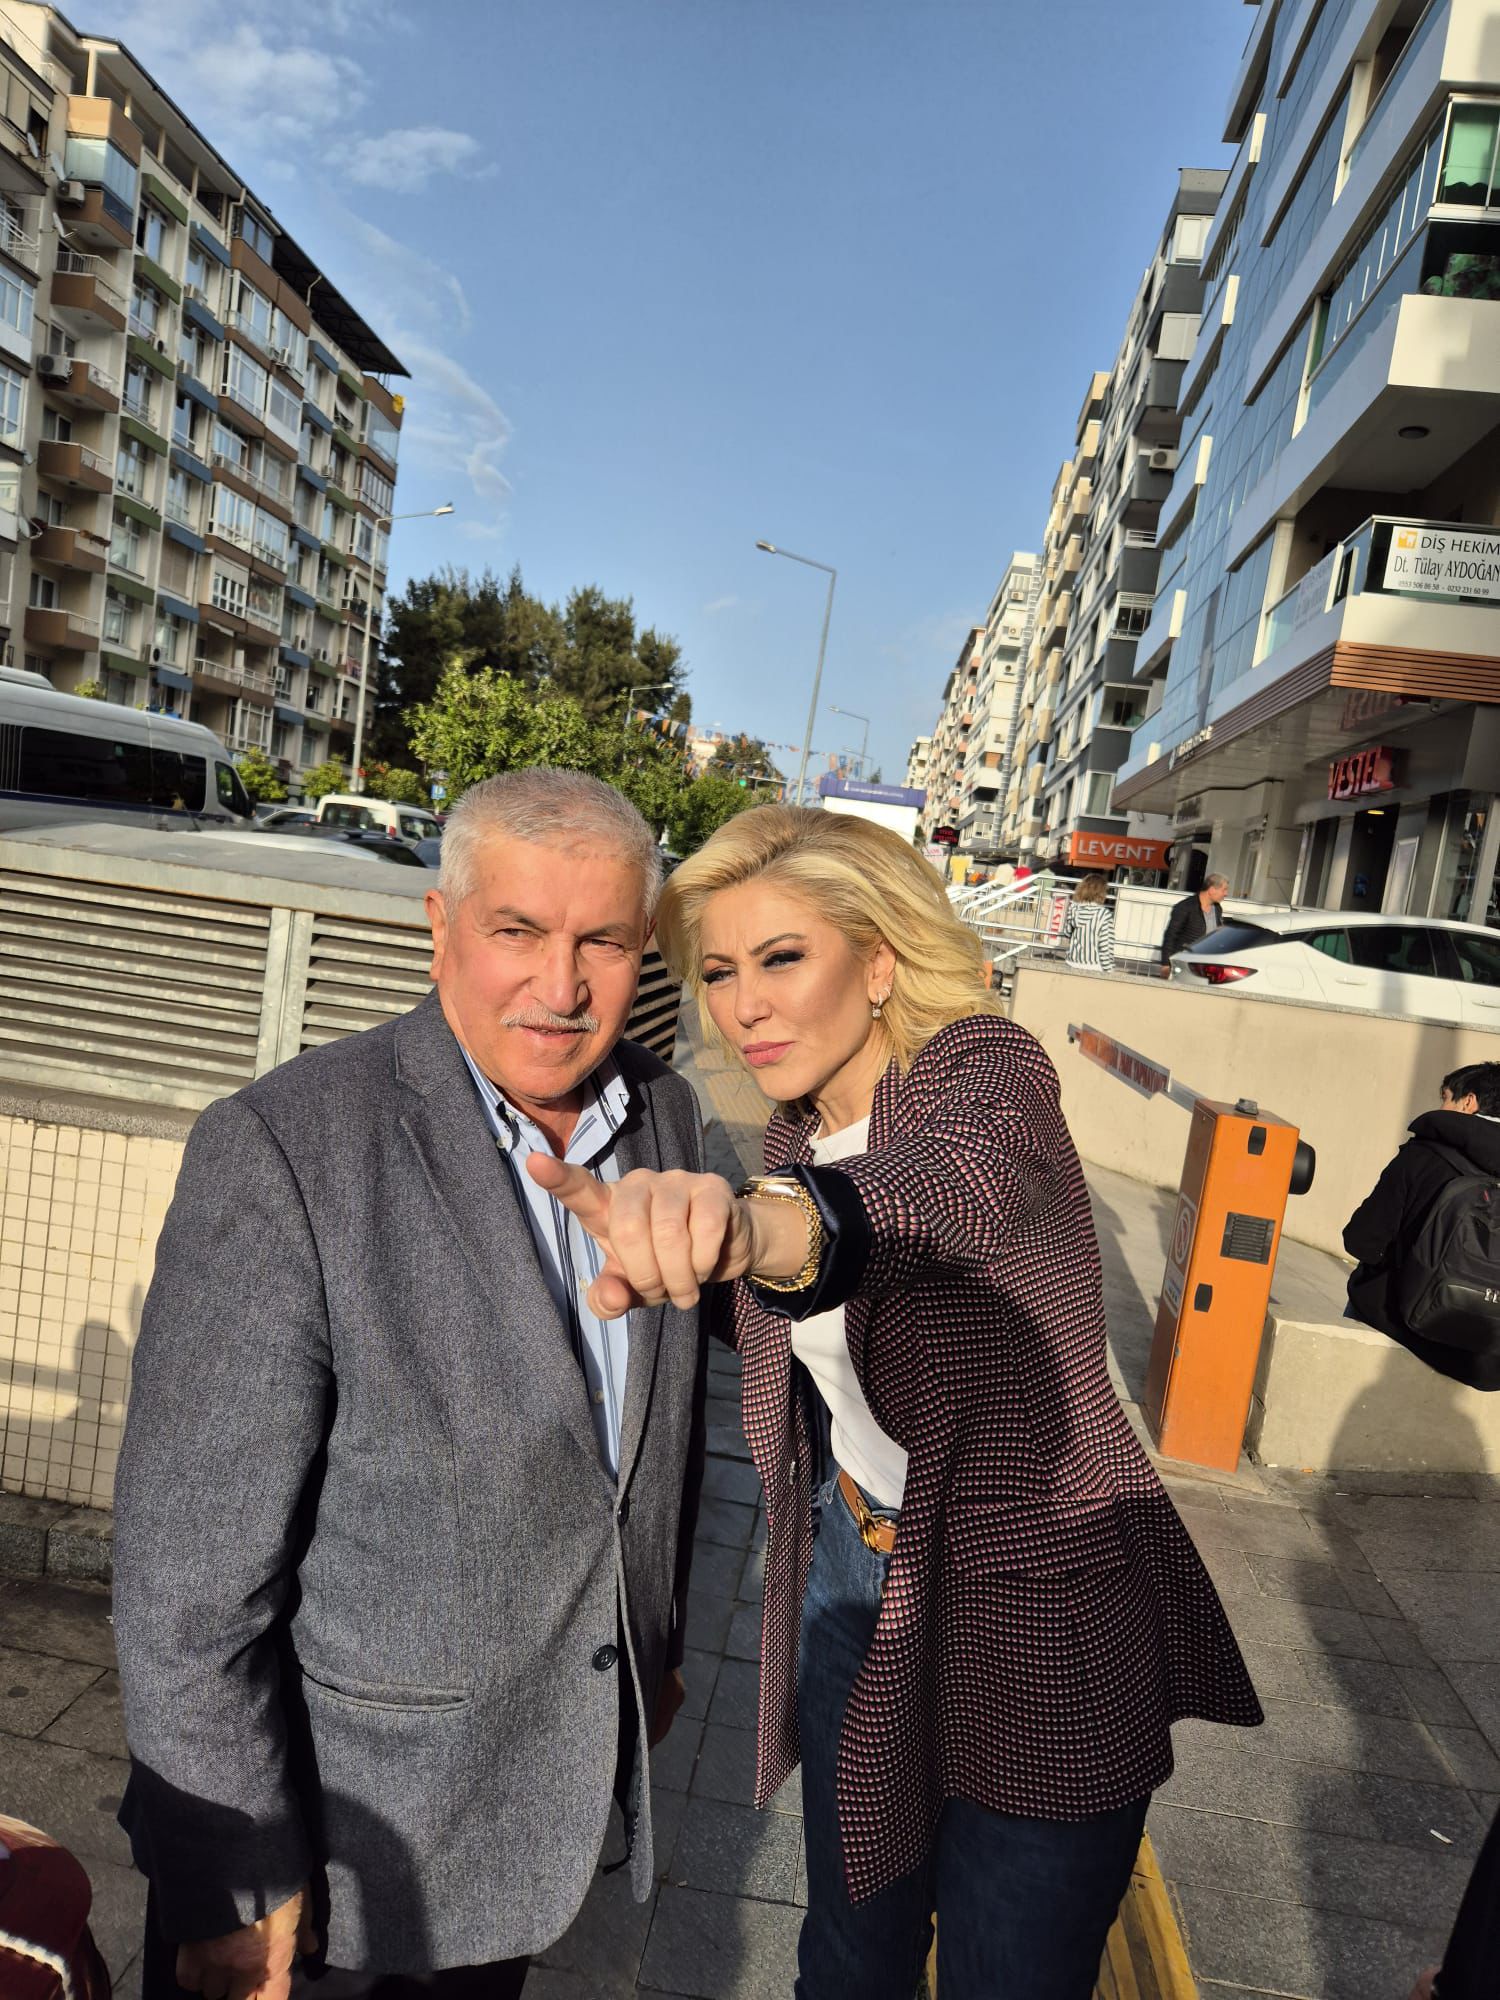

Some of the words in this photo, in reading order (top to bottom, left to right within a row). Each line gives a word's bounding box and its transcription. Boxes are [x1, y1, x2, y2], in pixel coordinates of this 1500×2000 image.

[1421, 534, 1446, 553] DİŞ
[1451, 538, 1500, 556] HEKİM
[1394, 555, 1409, 573] Dt.
[1414, 557, 1443, 580] Tülay
[1444, 560, 1500, 582] AYDOĞAN
[1447, 584, 1461, 592] 0232
[1462, 585, 1472, 594] 231
[1328, 748, 1393, 800] VESTEL
[1078, 839, 1156, 862] LEVENT
